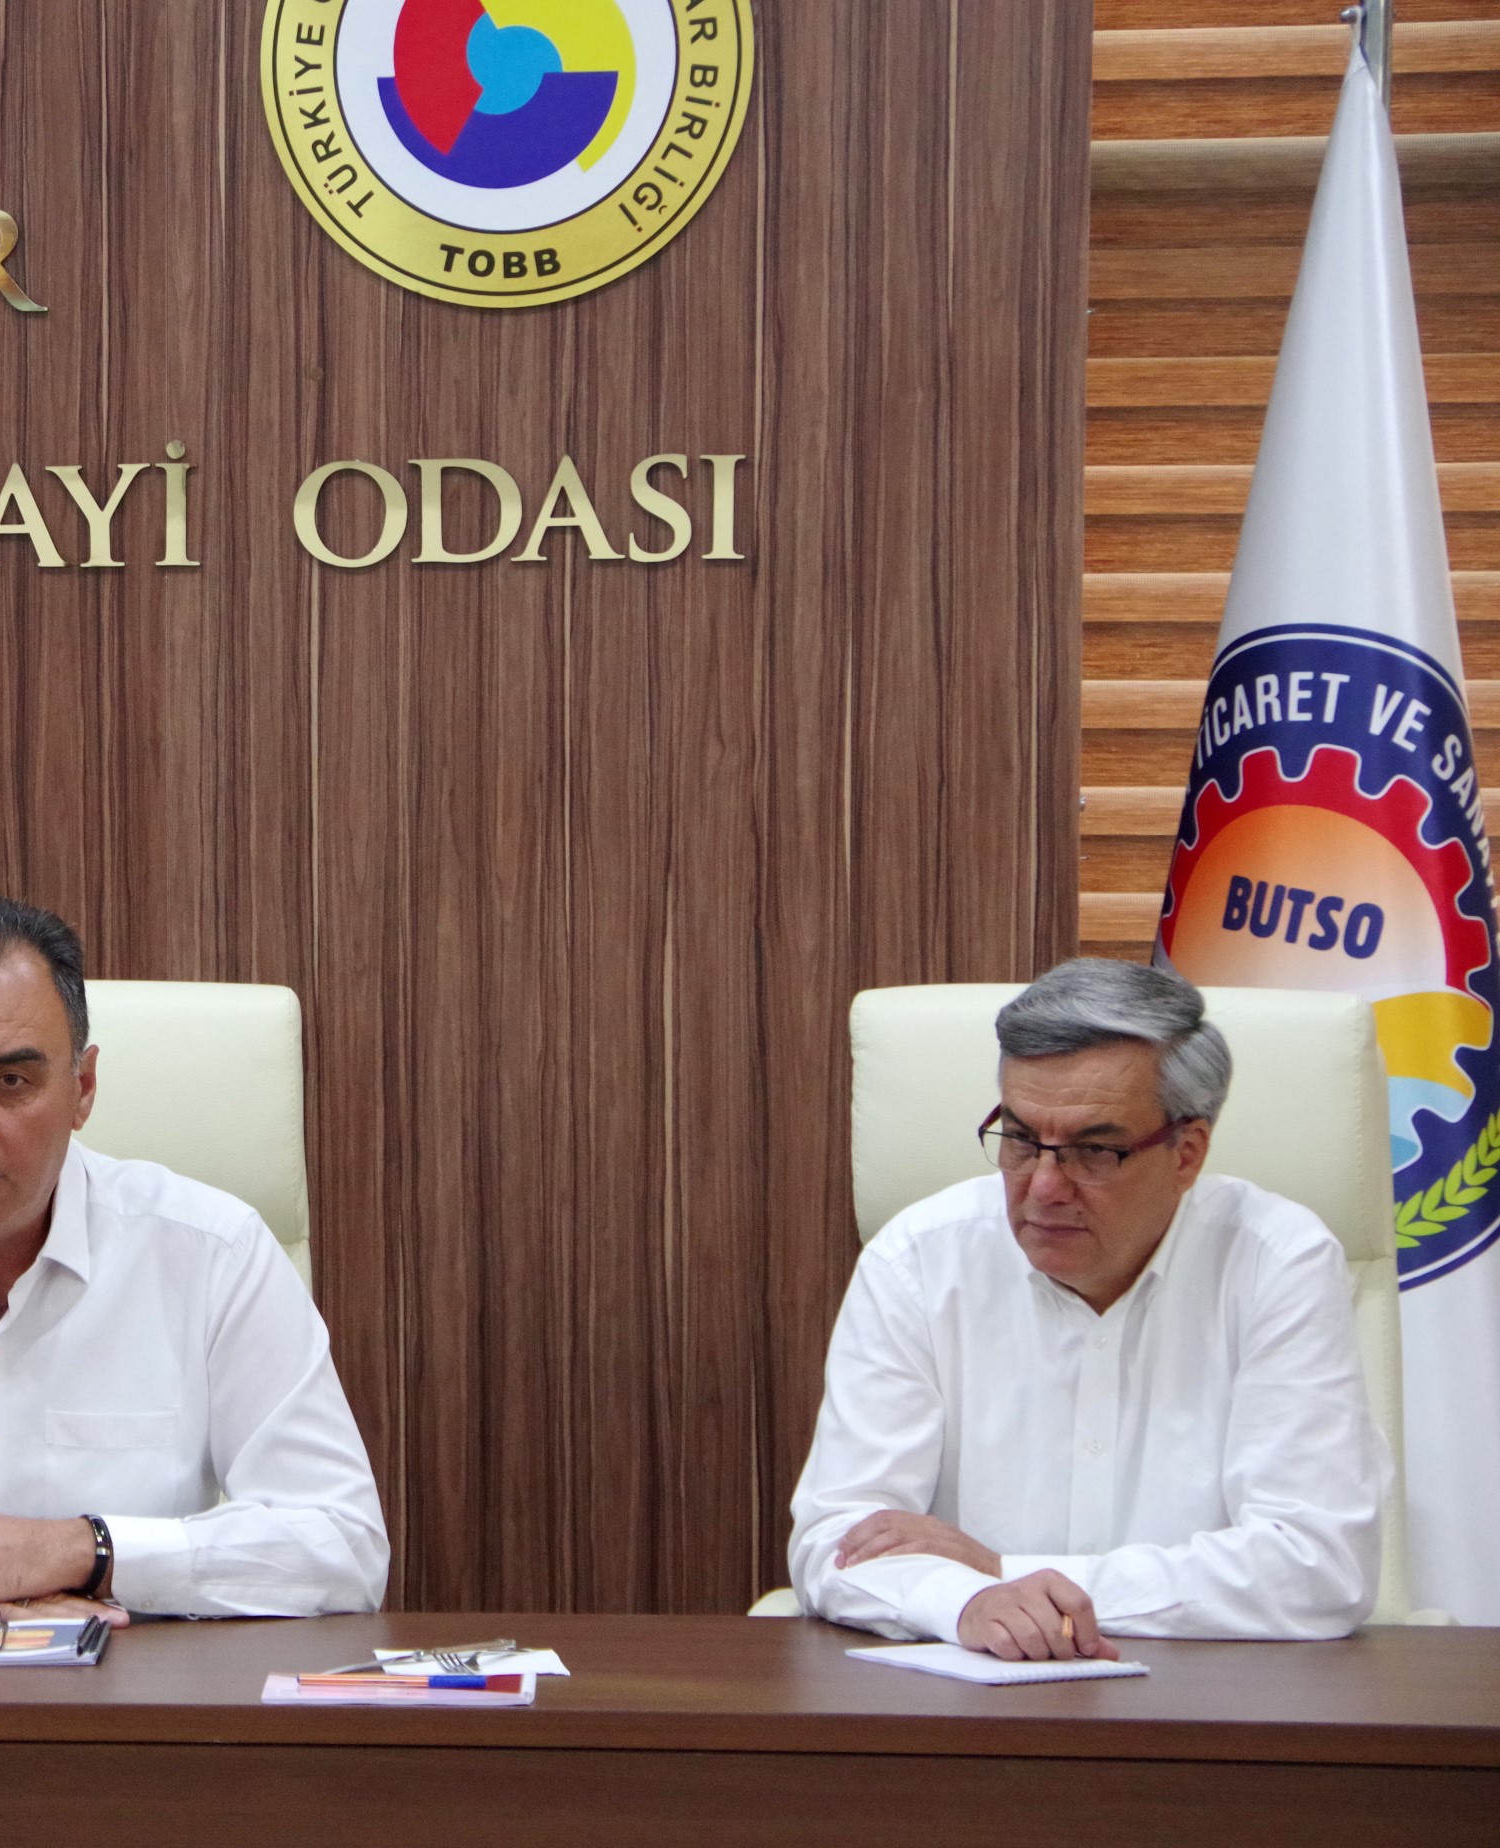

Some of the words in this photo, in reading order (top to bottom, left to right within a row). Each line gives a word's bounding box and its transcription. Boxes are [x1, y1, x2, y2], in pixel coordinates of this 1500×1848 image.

[288, 22, 375, 218] TÜRKİYE
[619, 64, 721, 232] BİRLİĞİ
[439, 243, 561, 279] TOBB
[293, 453, 747, 568] ODASI
[1369, 683, 1432, 752] VE
[1222, 875, 1385, 959] BUTSO
